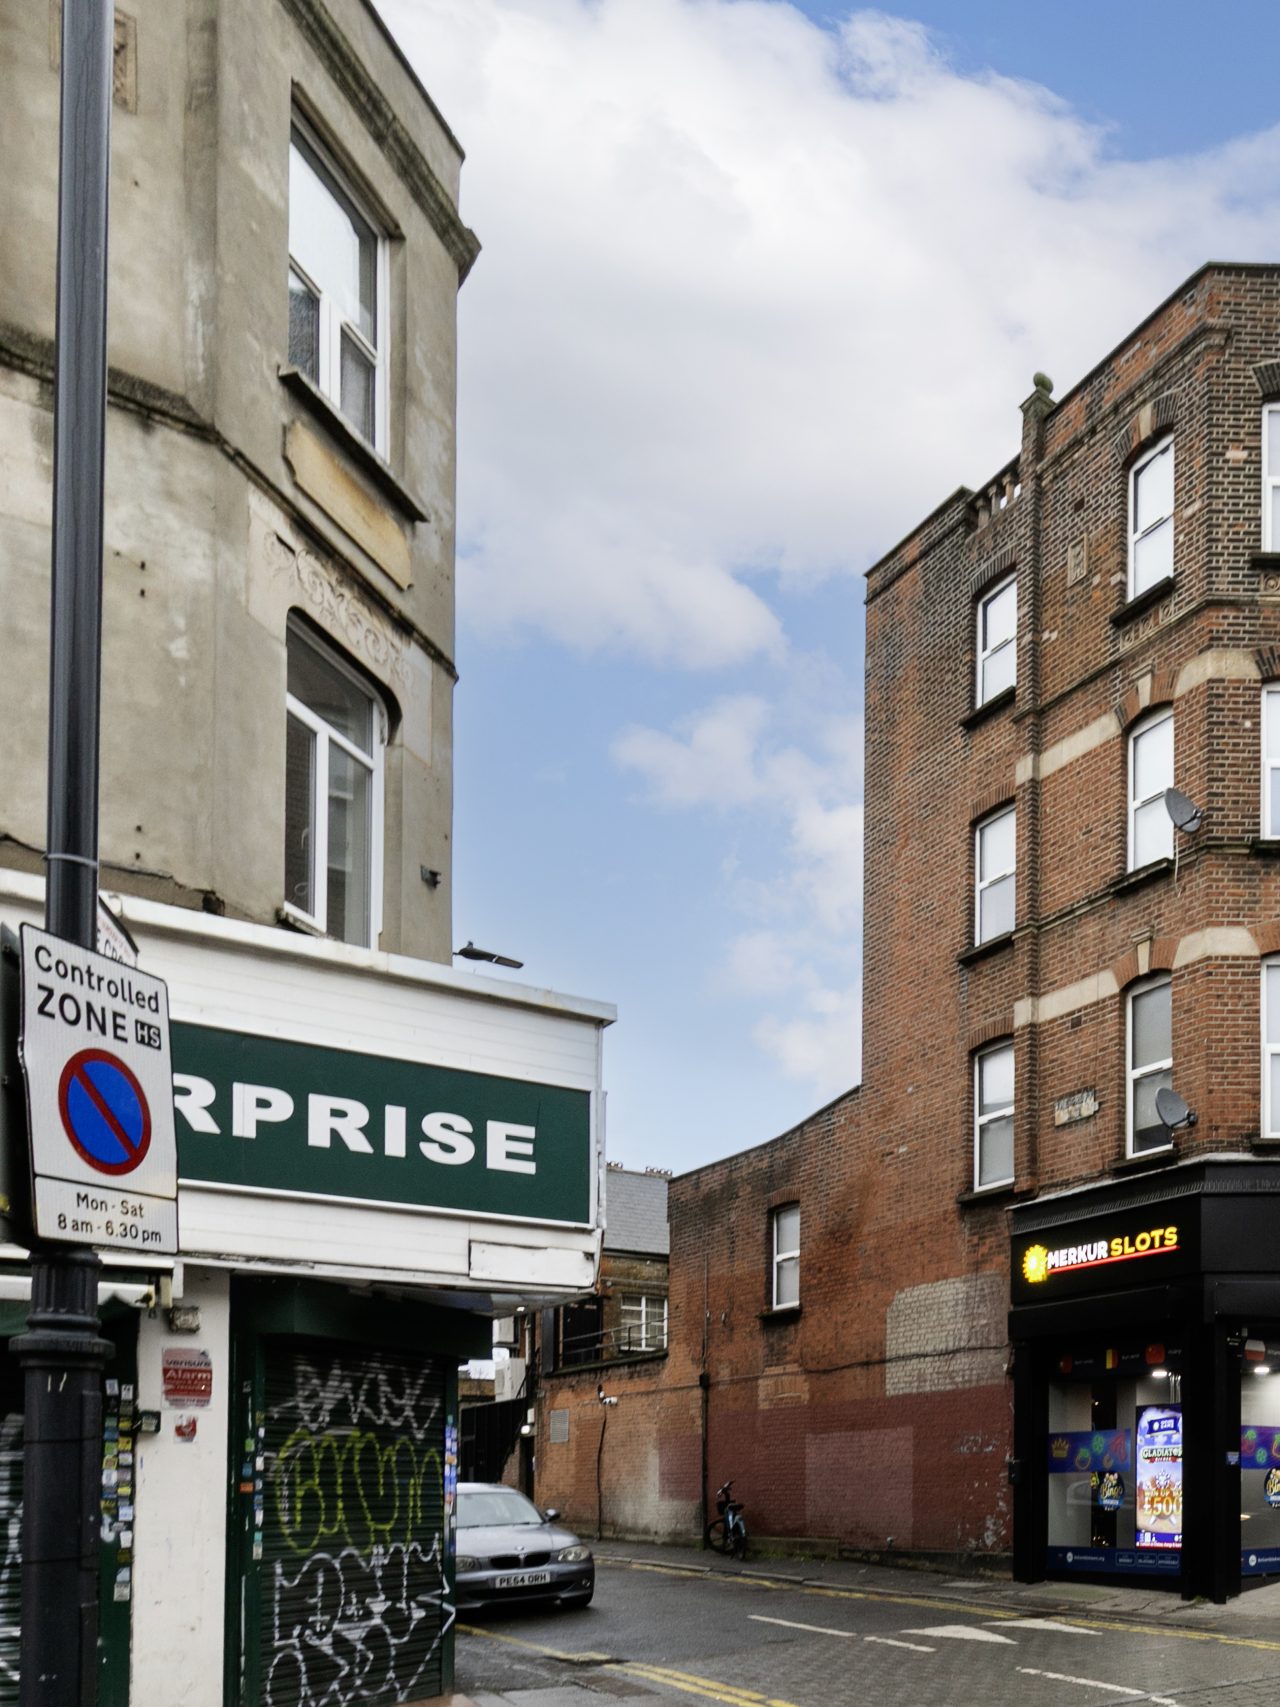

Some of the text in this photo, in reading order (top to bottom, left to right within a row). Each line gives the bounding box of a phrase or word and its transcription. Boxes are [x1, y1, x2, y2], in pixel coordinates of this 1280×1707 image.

[35, 945, 160, 1014] Controlled
[37, 983, 161, 1049] ZONE HS
[76, 1191, 108, 1212] Mon
[120, 1199, 145, 1219] Sat
[57, 1213, 68, 1230] 8
[71, 1218, 93, 1233] am
[105, 1220, 139, 1240] 6.30
[142, 1229, 162, 1243] pm
[1047, 1226, 1178, 1269] MERKUR SLOTS
[165, 1369, 211, 1380] Alarm
[1143, 1496, 1182, 1516] £500
